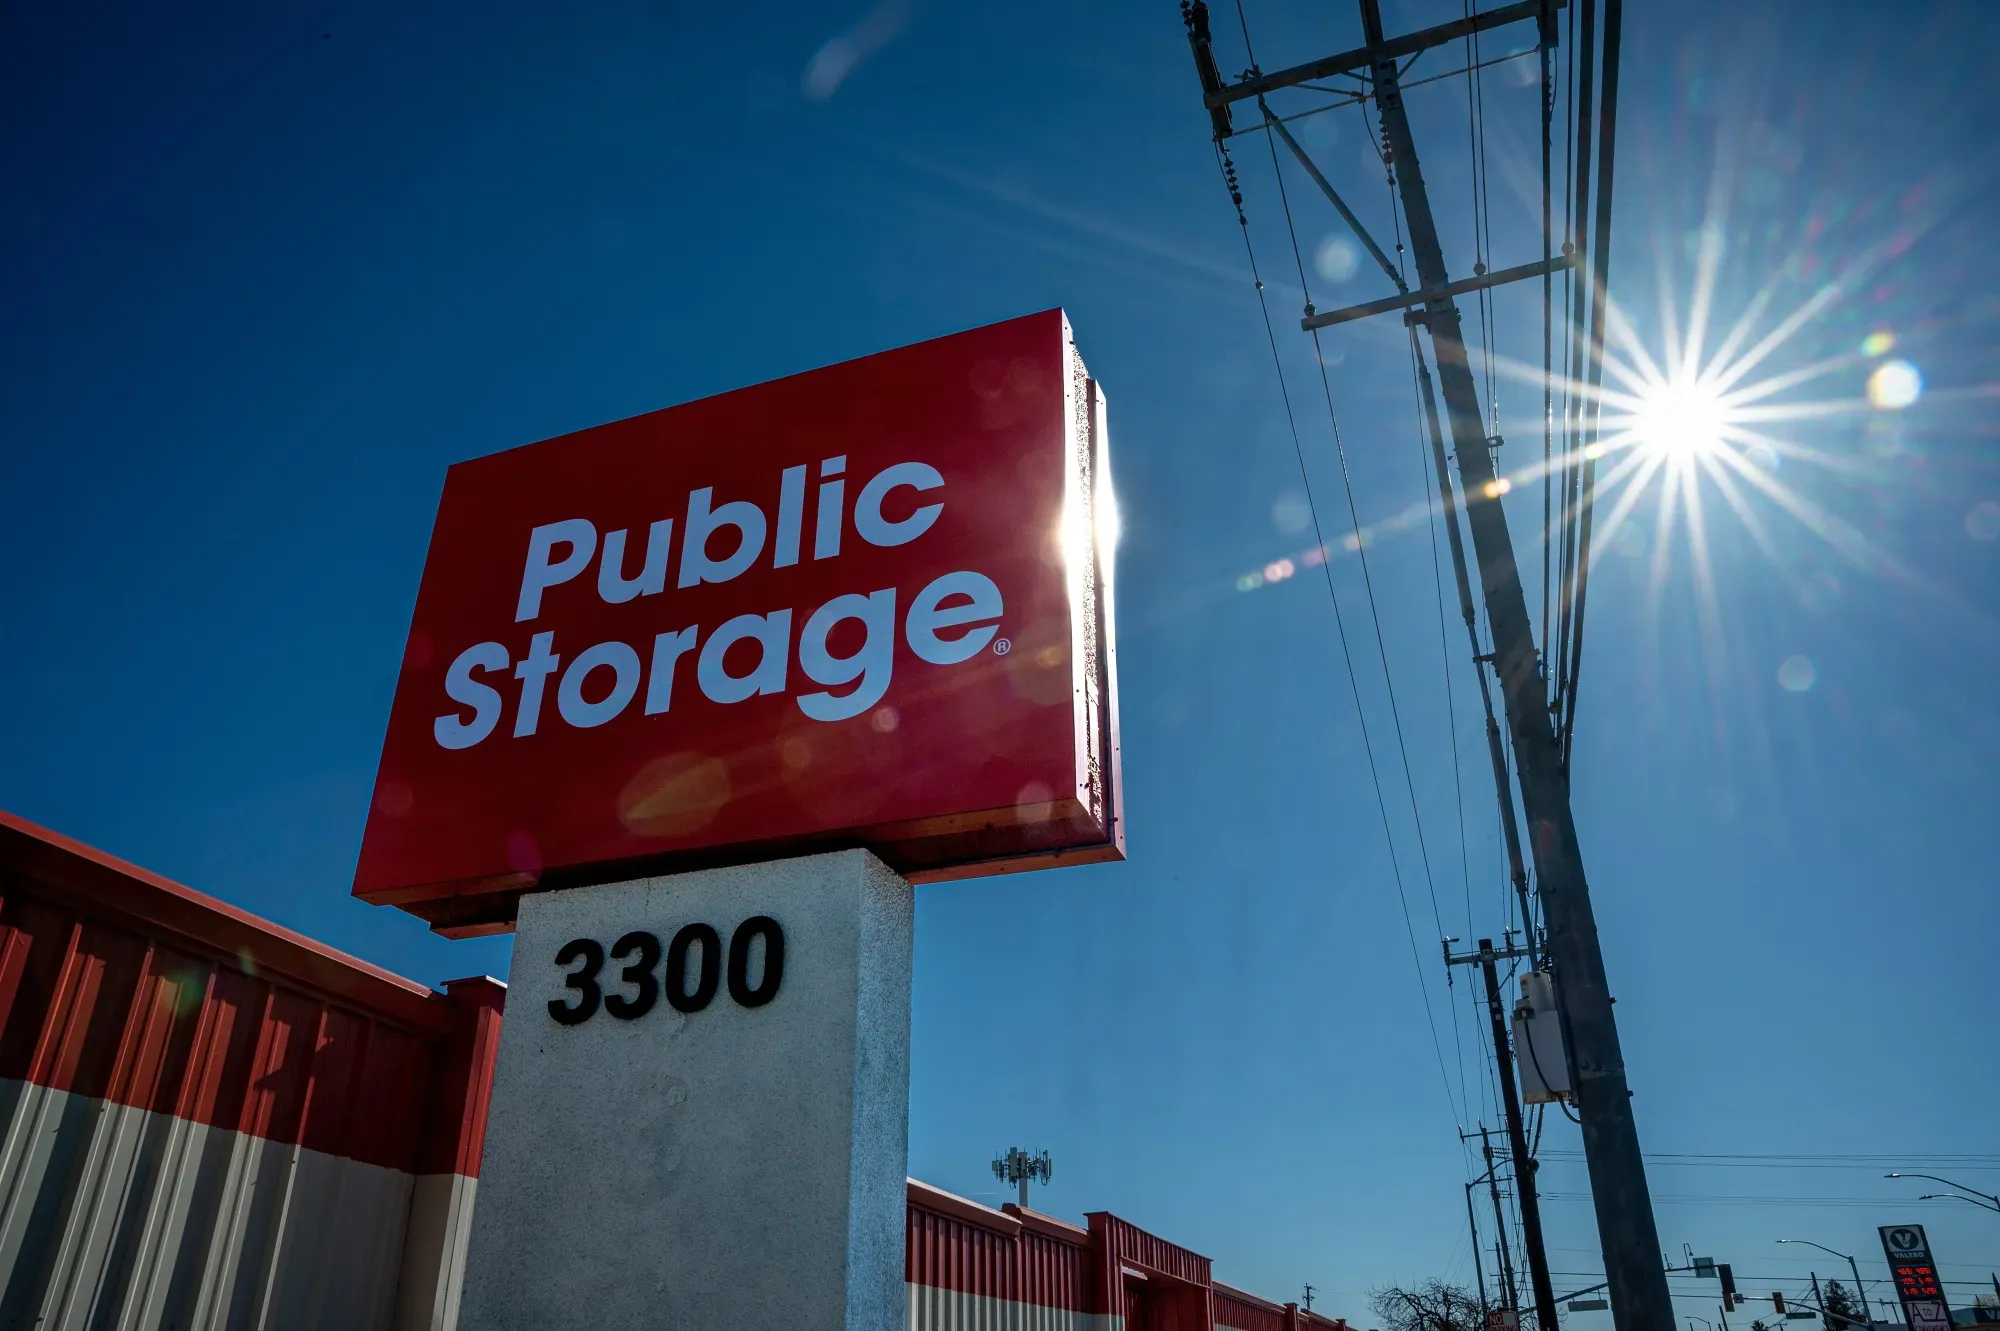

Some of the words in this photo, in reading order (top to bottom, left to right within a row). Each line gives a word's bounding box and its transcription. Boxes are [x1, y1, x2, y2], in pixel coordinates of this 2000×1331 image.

[515, 456, 944, 622] Public
[434, 571, 1003, 750] Storage
[547, 915, 785, 1027] 3300
[1490, 1314, 1503, 1325] NO
[1912, 1302, 1925, 1322] A
[1923, 1308, 1932, 1317] to
